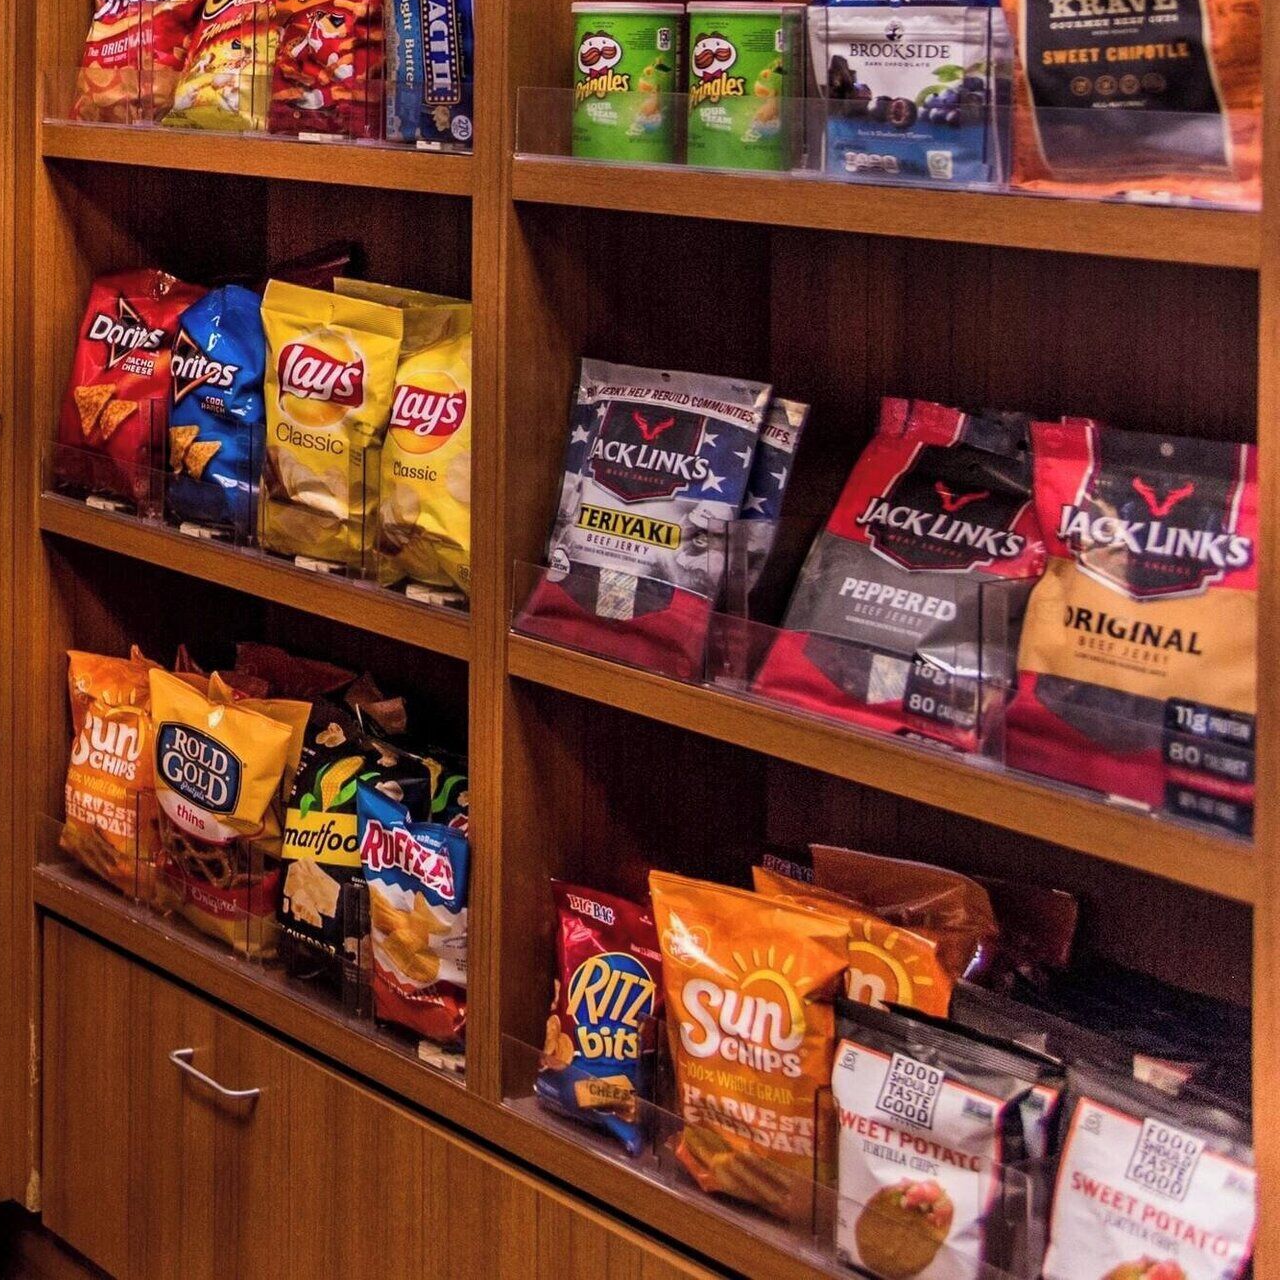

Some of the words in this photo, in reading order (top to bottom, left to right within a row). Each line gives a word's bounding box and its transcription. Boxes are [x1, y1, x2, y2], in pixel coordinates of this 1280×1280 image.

[429, 0, 449, 54] ACT
[405, 38, 415, 90] Butter
[849, 41, 950, 60] BROOKSIDE
[1043, 48, 1100, 65] SWEET
[1106, 43, 1188, 61] CHIPOTLE
[575, 70, 631, 102] Pringles
[689, 75, 745, 104] Pringles
[171, 355, 238, 387] oritos
[282, 345, 364, 400] Lay's
[391, 385, 465, 435] Lay's
[628, 388, 649, 400] HELP
[652, 391, 690, 405] REBUILD
[691, 396, 755, 425] COMMUNITIES.
[275, 422, 343, 455] Classic
[393, 460, 437, 481] Classic
[590, 436, 632, 469] JACK
[636, 440, 710, 481] LINK'S
[579, 505, 674, 546] TERIYAKI
[856, 498, 927, 529] JACK
[927, 512, 1026, 559] LINK'S
[1057, 505, 1144, 552] JACK
[1145, 521, 1252, 567] LINK'S
[839, 577, 957, 621] PEPPERED
[1064, 605, 1202, 656] ORIGINAL
[1124, 643, 1169, 664] JERKY
[909, 694, 934, 713] 80
[90, 753, 136, 780] CHIPS
[174, 728, 228, 775] ROLD
[1168, 742, 1199, 764] 80
[163, 751, 228, 806] GOLD
[177, 804, 205, 830] thins
[284, 821, 359, 855] martfoo
[361, 820, 455, 900] RUFFLES
[568, 893, 593, 914] BIG
[592, 902, 615, 925] BAG
[568, 957, 656, 1026] RITZ
[681, 978, 805, 1058] Sun
[577, 1025, 638, 1061] bits
[719, 1041, 802, 1078] CHIPS
[891, 1071, 936, 1100] SHOULD
[894, 1057, 939, 1086] FOOD
[883, 1095, 928, 1124] GOOD
[888, 1082, 931, 1109] TASTE
[1142, 1139, 1192, 1171] SHOULD
[1144, 1124, 1196, 1156] FOOD
[1132, 1167, 1183, 1197] GOOD
[1137, 1152, 1187, 1182] TASTE
[1071, 1171, 1138, 1215] SWEET
[1142, 1204, 1230, 1259] POTATO
